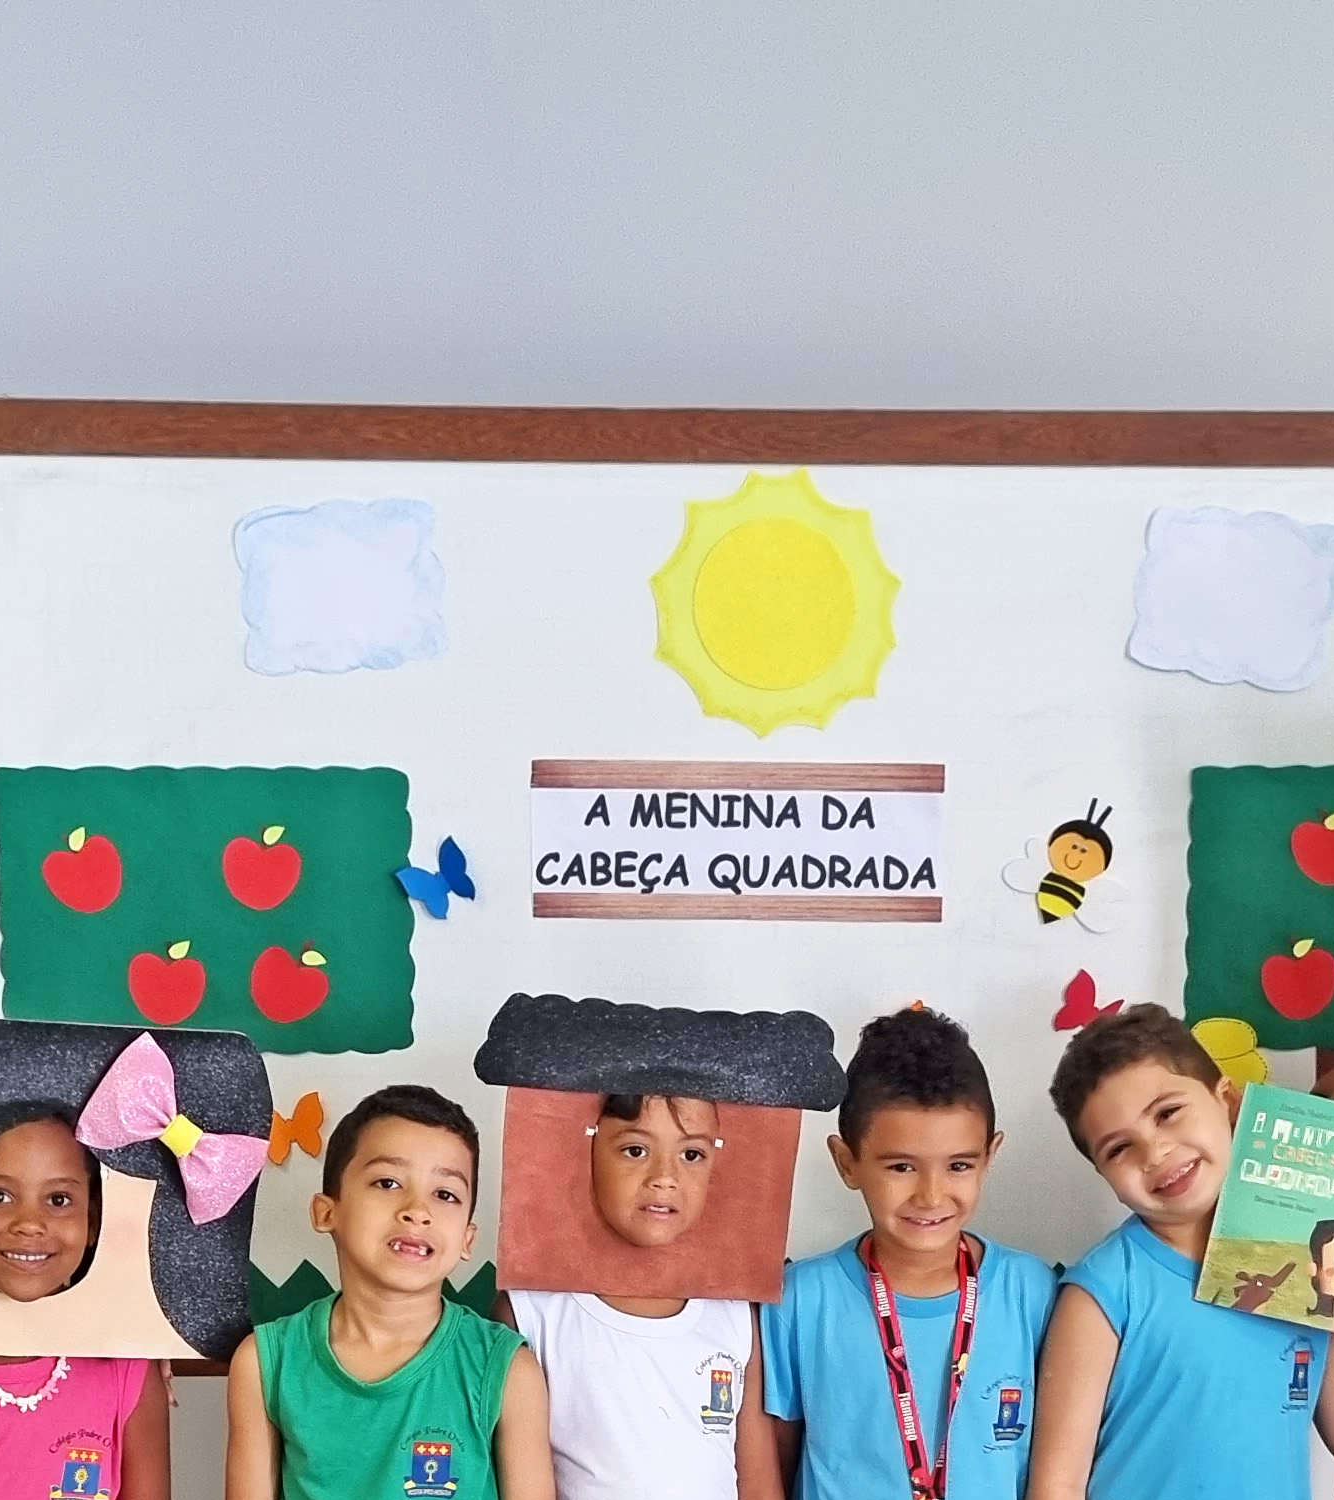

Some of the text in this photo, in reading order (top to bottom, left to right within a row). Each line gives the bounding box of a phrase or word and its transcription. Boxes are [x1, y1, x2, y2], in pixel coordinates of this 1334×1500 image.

[584, 792, 876, 829] A MENINA DA
[535, 851, 937, 894] CABEÇA QUADRADA
[961, 1275, 979, 1324] Flamengo
[897, 1391, 918, 1442] Flamengo
